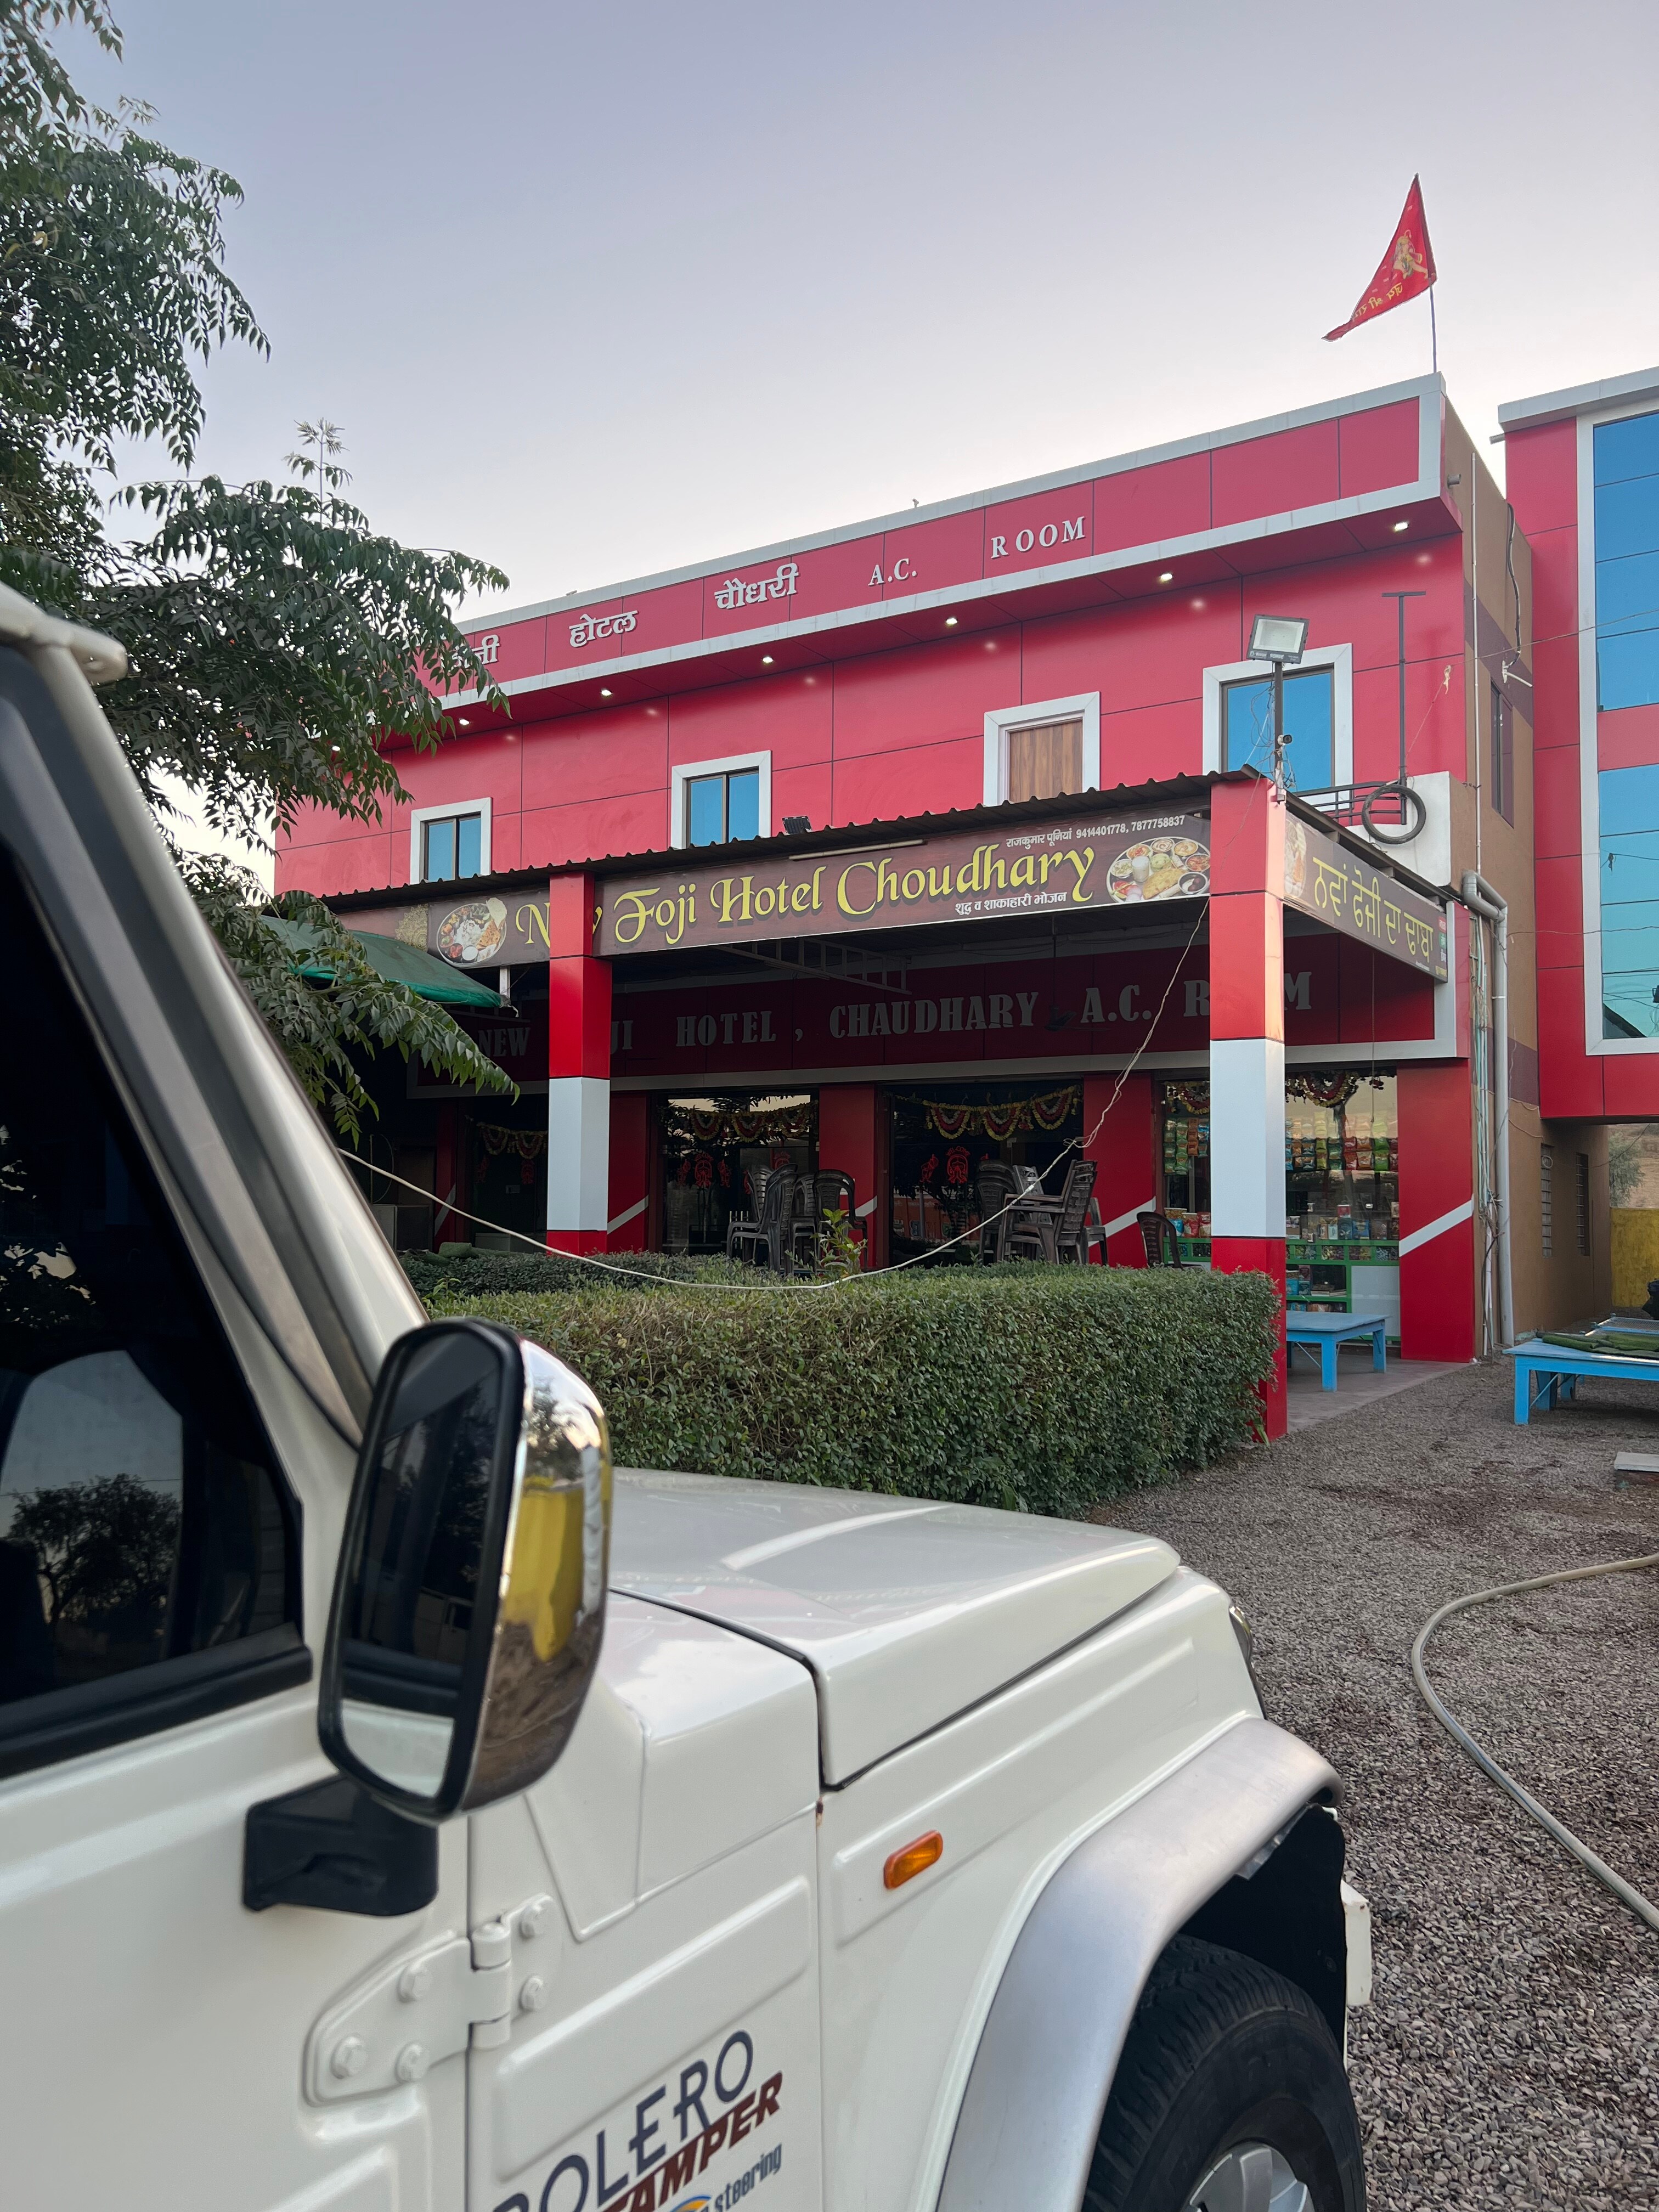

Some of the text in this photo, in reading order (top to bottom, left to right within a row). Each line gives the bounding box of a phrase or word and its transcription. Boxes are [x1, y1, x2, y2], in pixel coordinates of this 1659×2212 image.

[868, 516, 1085, 586] A.C. ROOM
[569, 563, 799, 647] होटल चौधरी
[1006, 834, 1046, 849] राजकुमार
[1076, 823, 1129, 839] 9414401778,
[1131, 815, 1186, 831] 7877758837
[614, 883, 697, 945] Foji
[710, 866, 826, 922] Hotel
[837, 844, 1094, 915] Choudhary
[974, 901, 982, 911] व
[984, 893, 1032, 911] शाकाहारी
[1034, 892, 1068, 904] भोजन
[478, 1027, 531, 1057] NEW
[675, 1011, 777, 1047] HOTEL
[830, 991, 1039, 1039] CHAUDHARY
[1080, 985, 1152, 1024] A.C.
[1183, 972, 1312, 1017] RM
[493, 2030, 753, 2212] OLERO
[714, 2144, 782, 2212] steering
